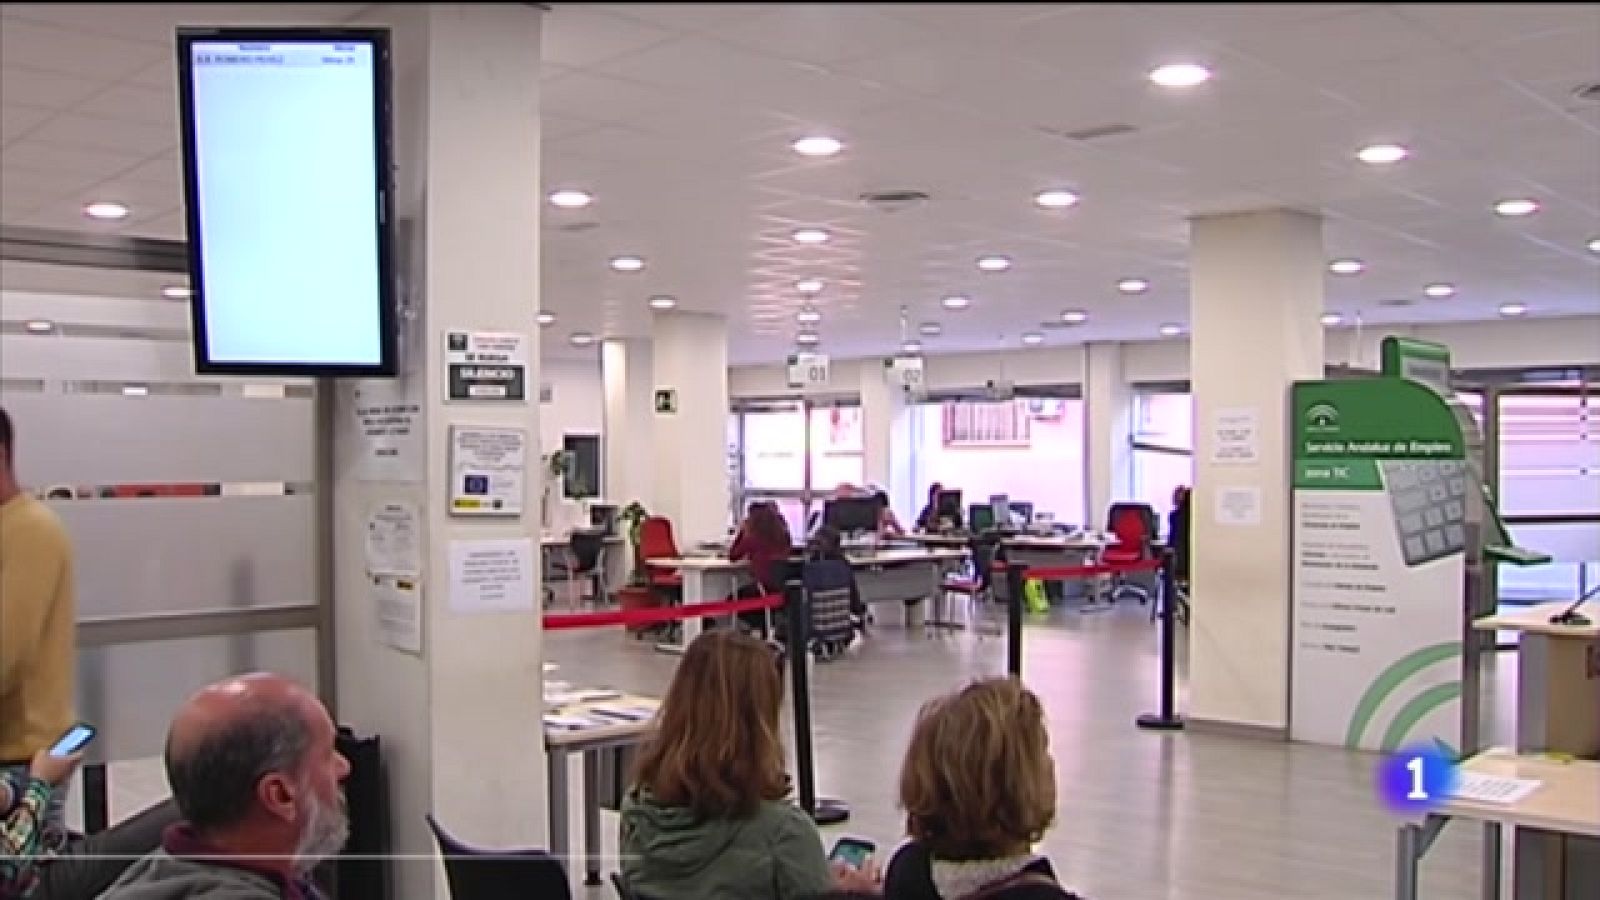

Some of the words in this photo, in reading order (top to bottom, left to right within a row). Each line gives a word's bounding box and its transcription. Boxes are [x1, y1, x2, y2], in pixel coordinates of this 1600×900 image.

[809, 366, 826, 381] 01
[1304, 440, 1345, 453] Servicio
[1347, 441, 1391, 453] Andaluz
[1393, 442, 1407, 453] de
[1409, 440, 1452, 456] Empleo
